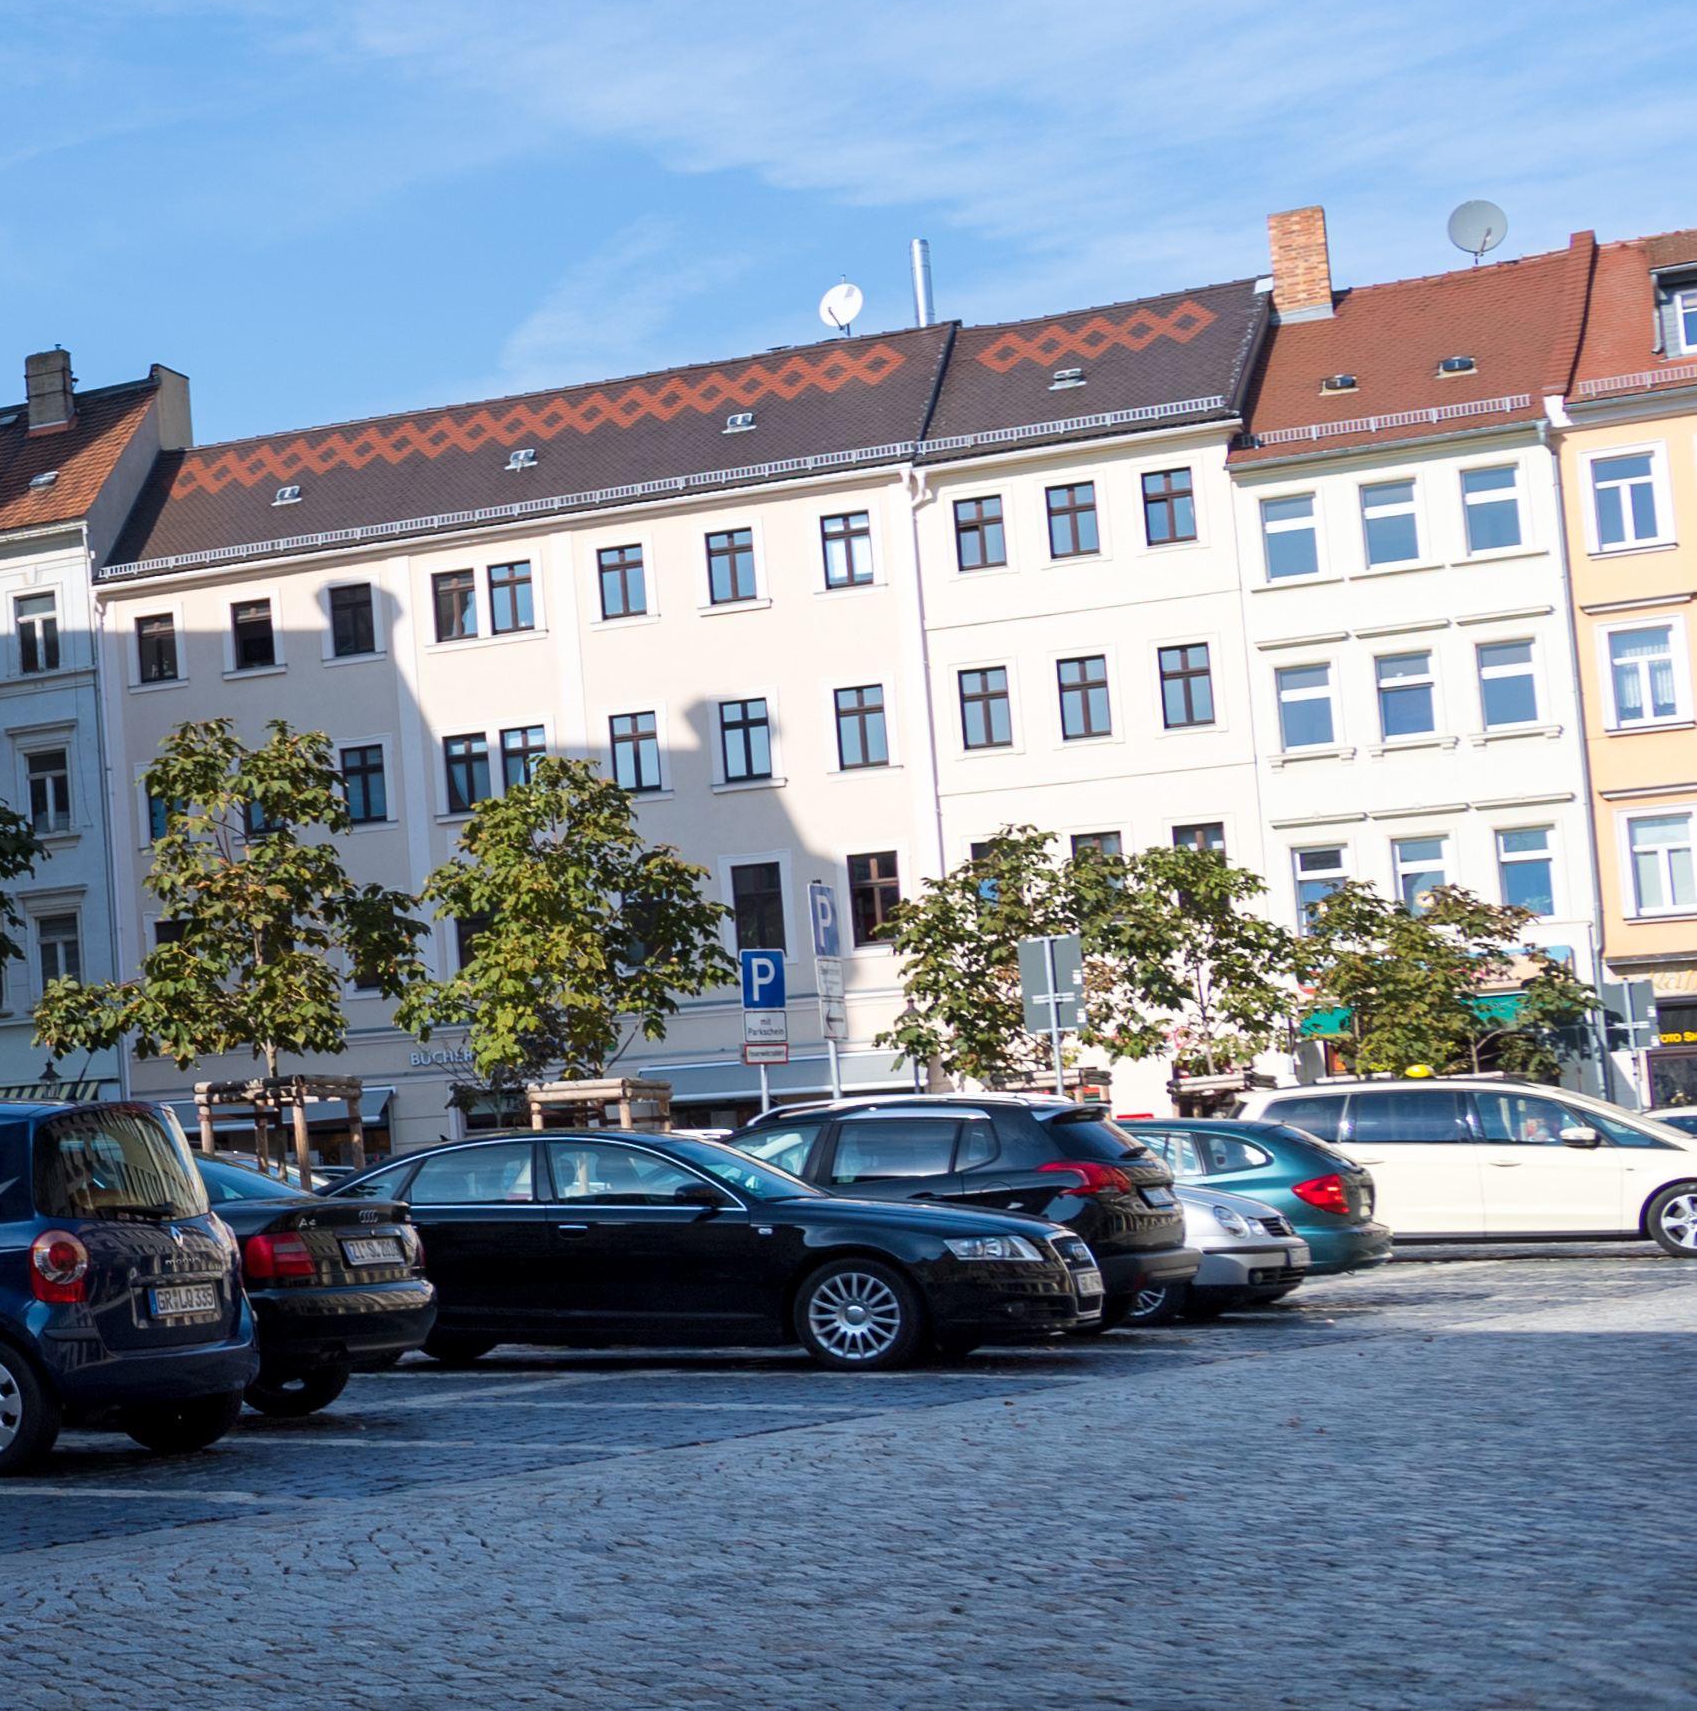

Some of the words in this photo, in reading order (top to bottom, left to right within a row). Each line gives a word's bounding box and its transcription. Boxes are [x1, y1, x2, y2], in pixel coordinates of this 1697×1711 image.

[816, 895, 832, 947] P
[751, 957, 775, 1001] P
[748, 1026, 784, 1036] Parkschein
[760, 1017, 771, 1026] mit
[157, 1290, 173, 1310] GR
[178, 1288, 194, 1309] LQ
[194, 1287, 213, 1307] 335
